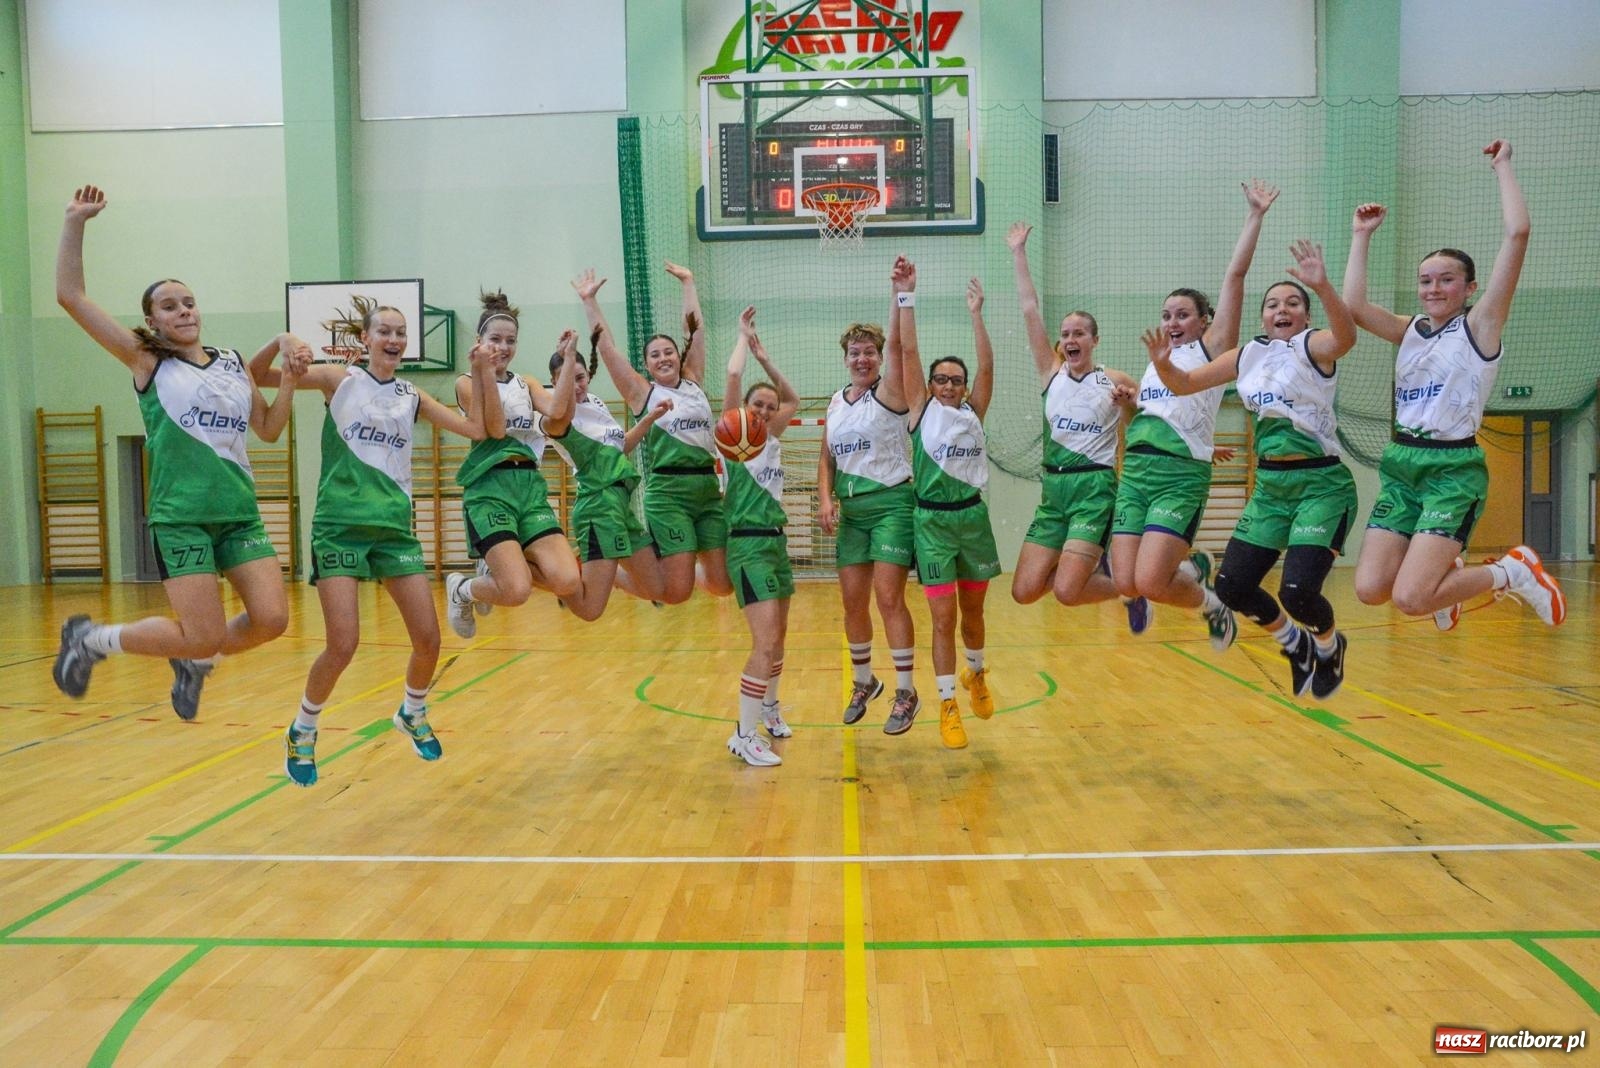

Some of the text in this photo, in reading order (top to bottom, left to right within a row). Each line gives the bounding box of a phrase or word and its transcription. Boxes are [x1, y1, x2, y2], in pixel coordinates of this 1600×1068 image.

[769, 142, 778, 155] 0
[895, 139, 905, 152] 0
[779, 189, 793, 209] 0
[198, 411, 247, 433] Clavis
[1057, 418, 1103, 434] Clavis
[358, 425, 408, 449] Clavis
[835, 438, 871, 456] Clavis
[946, 444, 983, 458] Clavis
[172, 543, 208, 569] 77
[322, 550, 358, 569] 30
